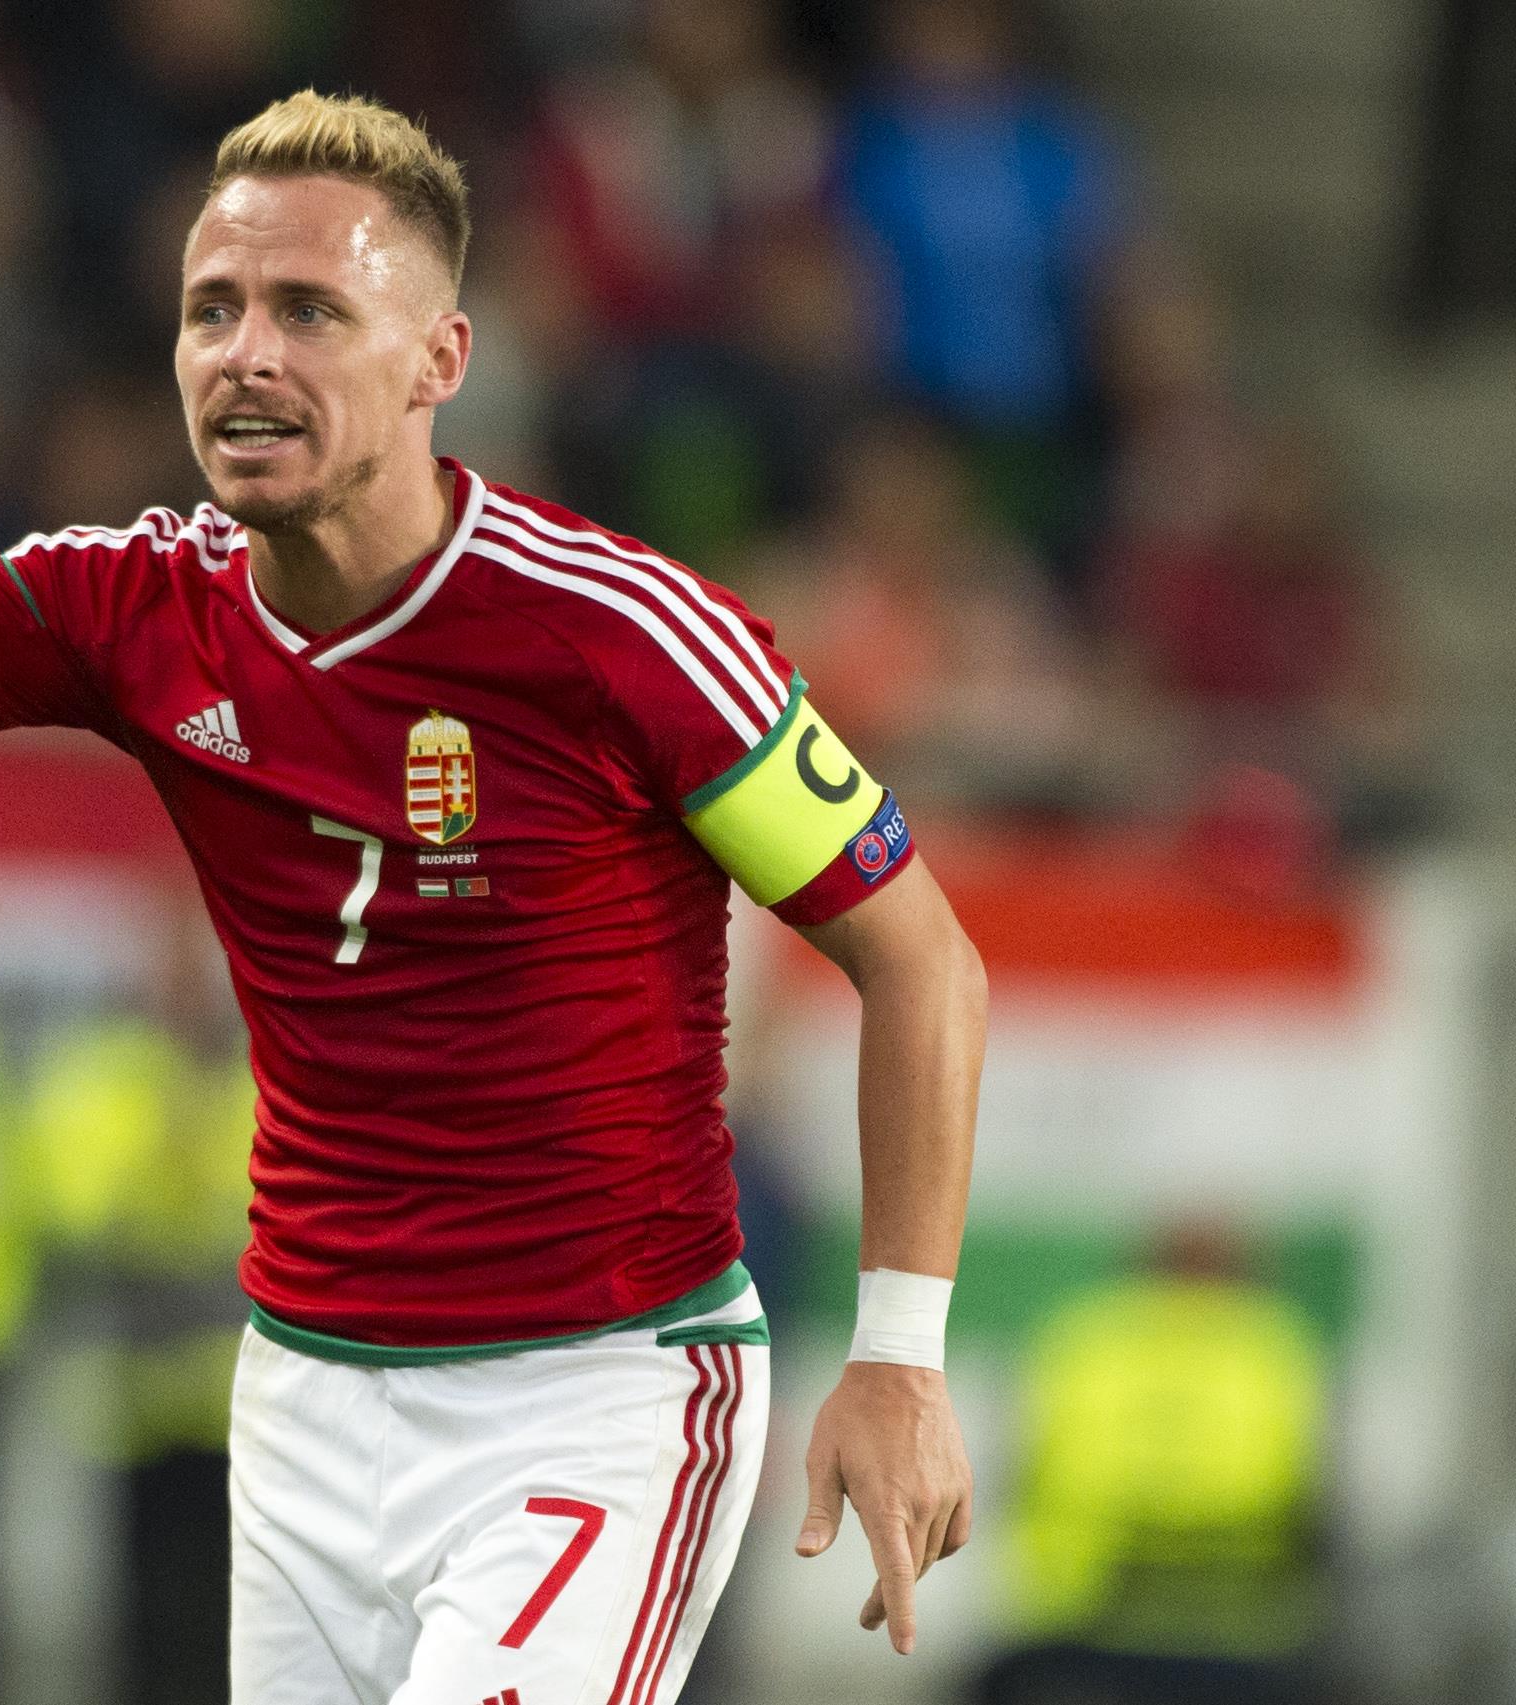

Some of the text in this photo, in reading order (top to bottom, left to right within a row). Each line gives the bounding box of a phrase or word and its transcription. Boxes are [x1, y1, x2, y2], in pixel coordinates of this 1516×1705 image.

[176, 723, 251, 763] adidas
[796, 724, 860, 804] C
[311, 815, 383, 963] 7
[418, 853, 479, 865] BUDAPEST
[498, 1497, 606, 1649] 7
